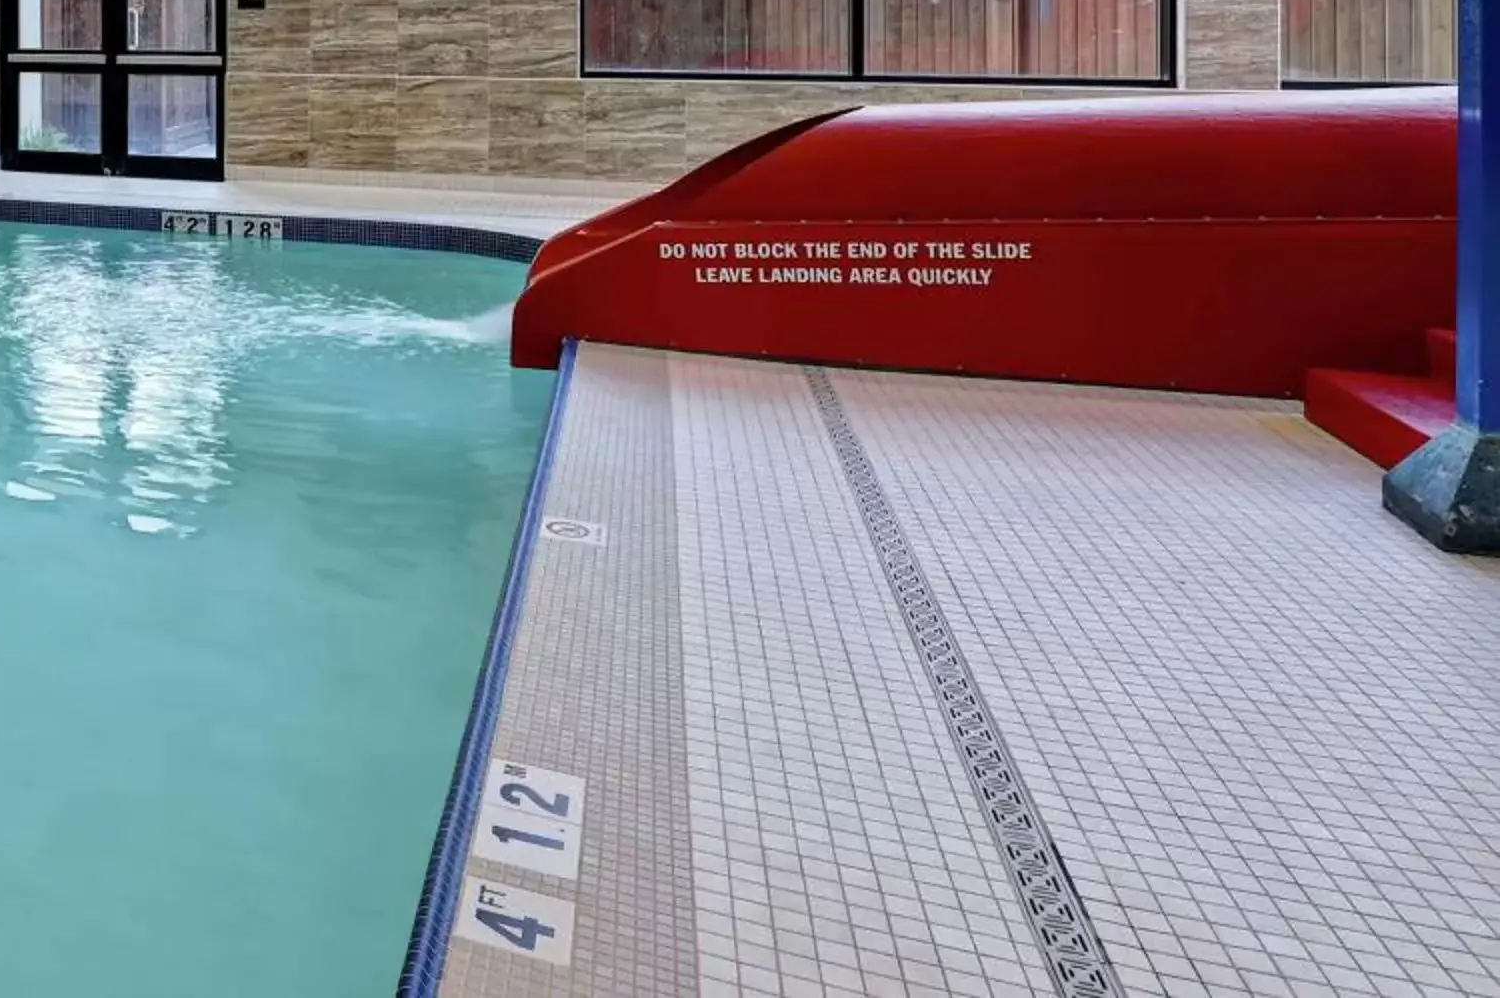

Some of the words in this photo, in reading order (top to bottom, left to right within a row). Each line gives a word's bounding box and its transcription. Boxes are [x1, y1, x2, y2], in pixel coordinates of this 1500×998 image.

[659, 243, 685, 259] DO
[691, 243, 728, 259] NOT
[734, 243, 798, 259] BLOCK
[804, 243, 841, 259] THE
[847, 243, 887, 259] END
[893, 243, 919, 259] OF
[925, 243, 966, 259] THE
[972, 243, 1032, 259] SLIDE
[695, 268, 753, 283] LEAVE
[759, 268, 842, 283] LANDING
[849, 268, 902, 283] AREA
[908, 268, 993, 286] QUICKLY
